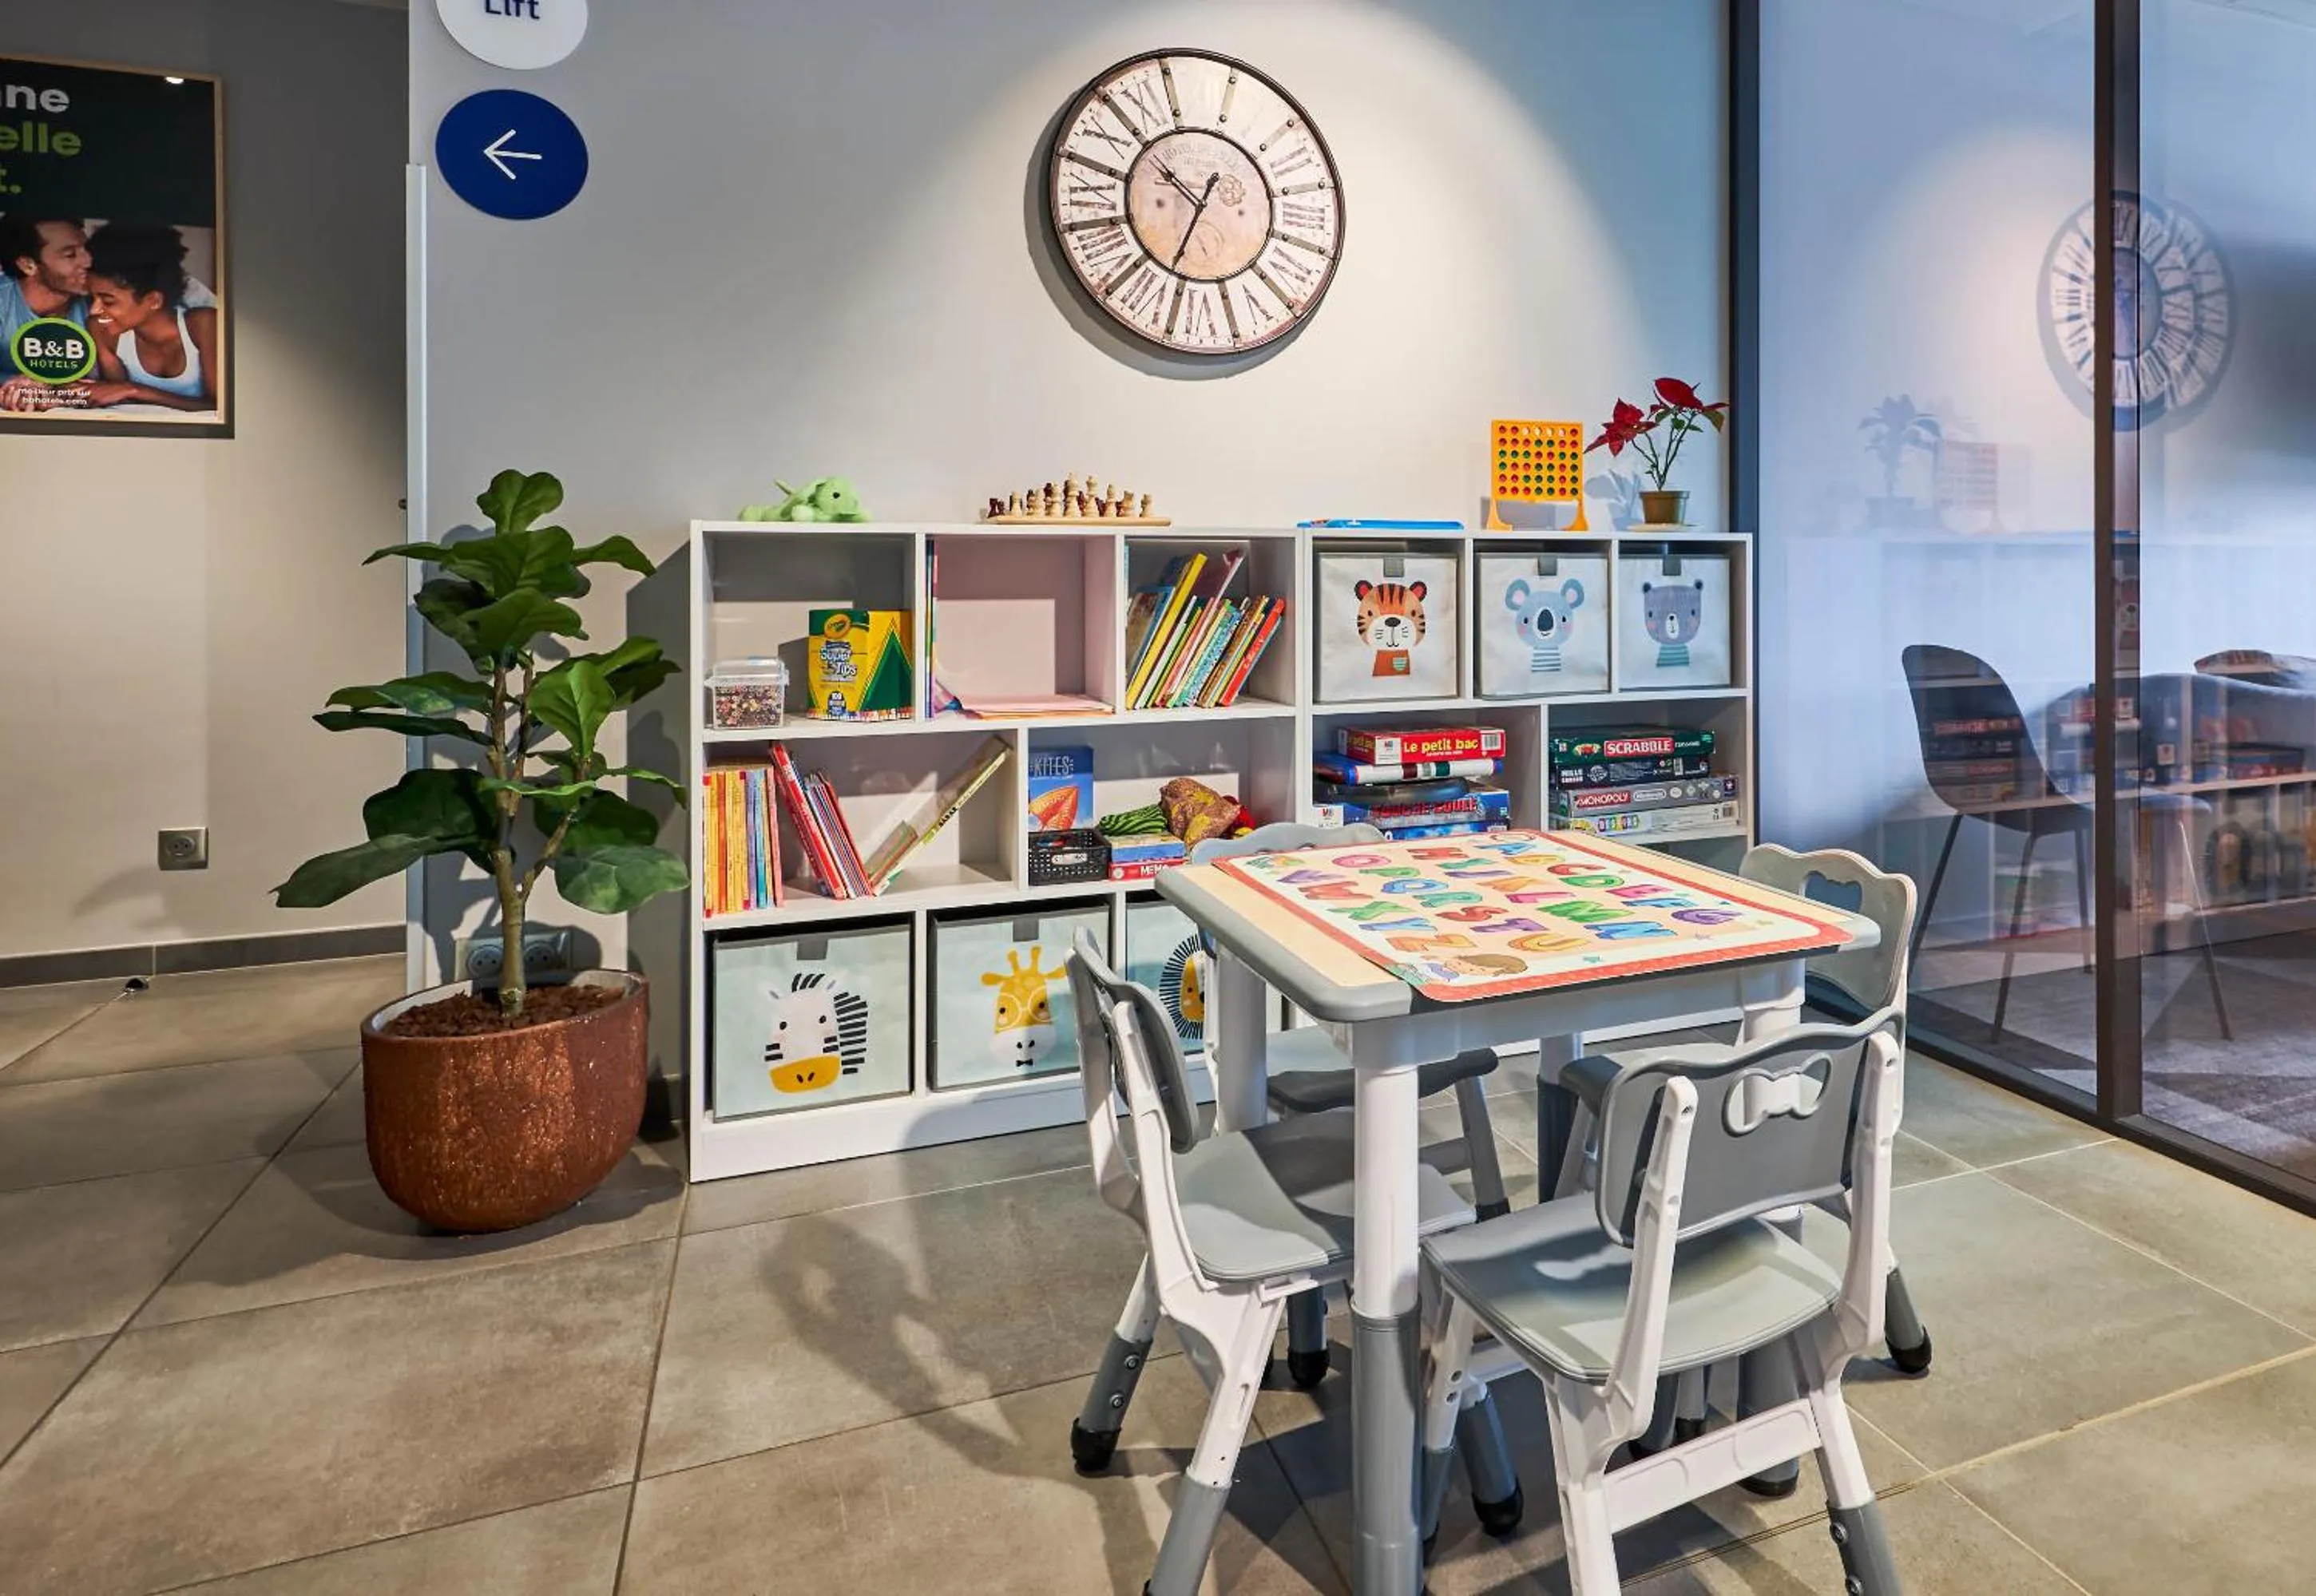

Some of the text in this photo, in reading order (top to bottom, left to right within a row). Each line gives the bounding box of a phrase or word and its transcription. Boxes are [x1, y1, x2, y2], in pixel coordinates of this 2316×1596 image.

[485, 0, 540, 19] Lift
[0, 84, 70, 113] ne
[24, 337, 84, 359] B&B
[30, 359, 78, 369] HOTELS
[1403, 741, 1418, 753] Le
[1422, 738, 1452, 754] petit
[1455, 739, 1478, 750] bac
[1606, 740, 1672, 754] SCRABBLE
[1576, 792, 1629, 806] MONOPOLY
